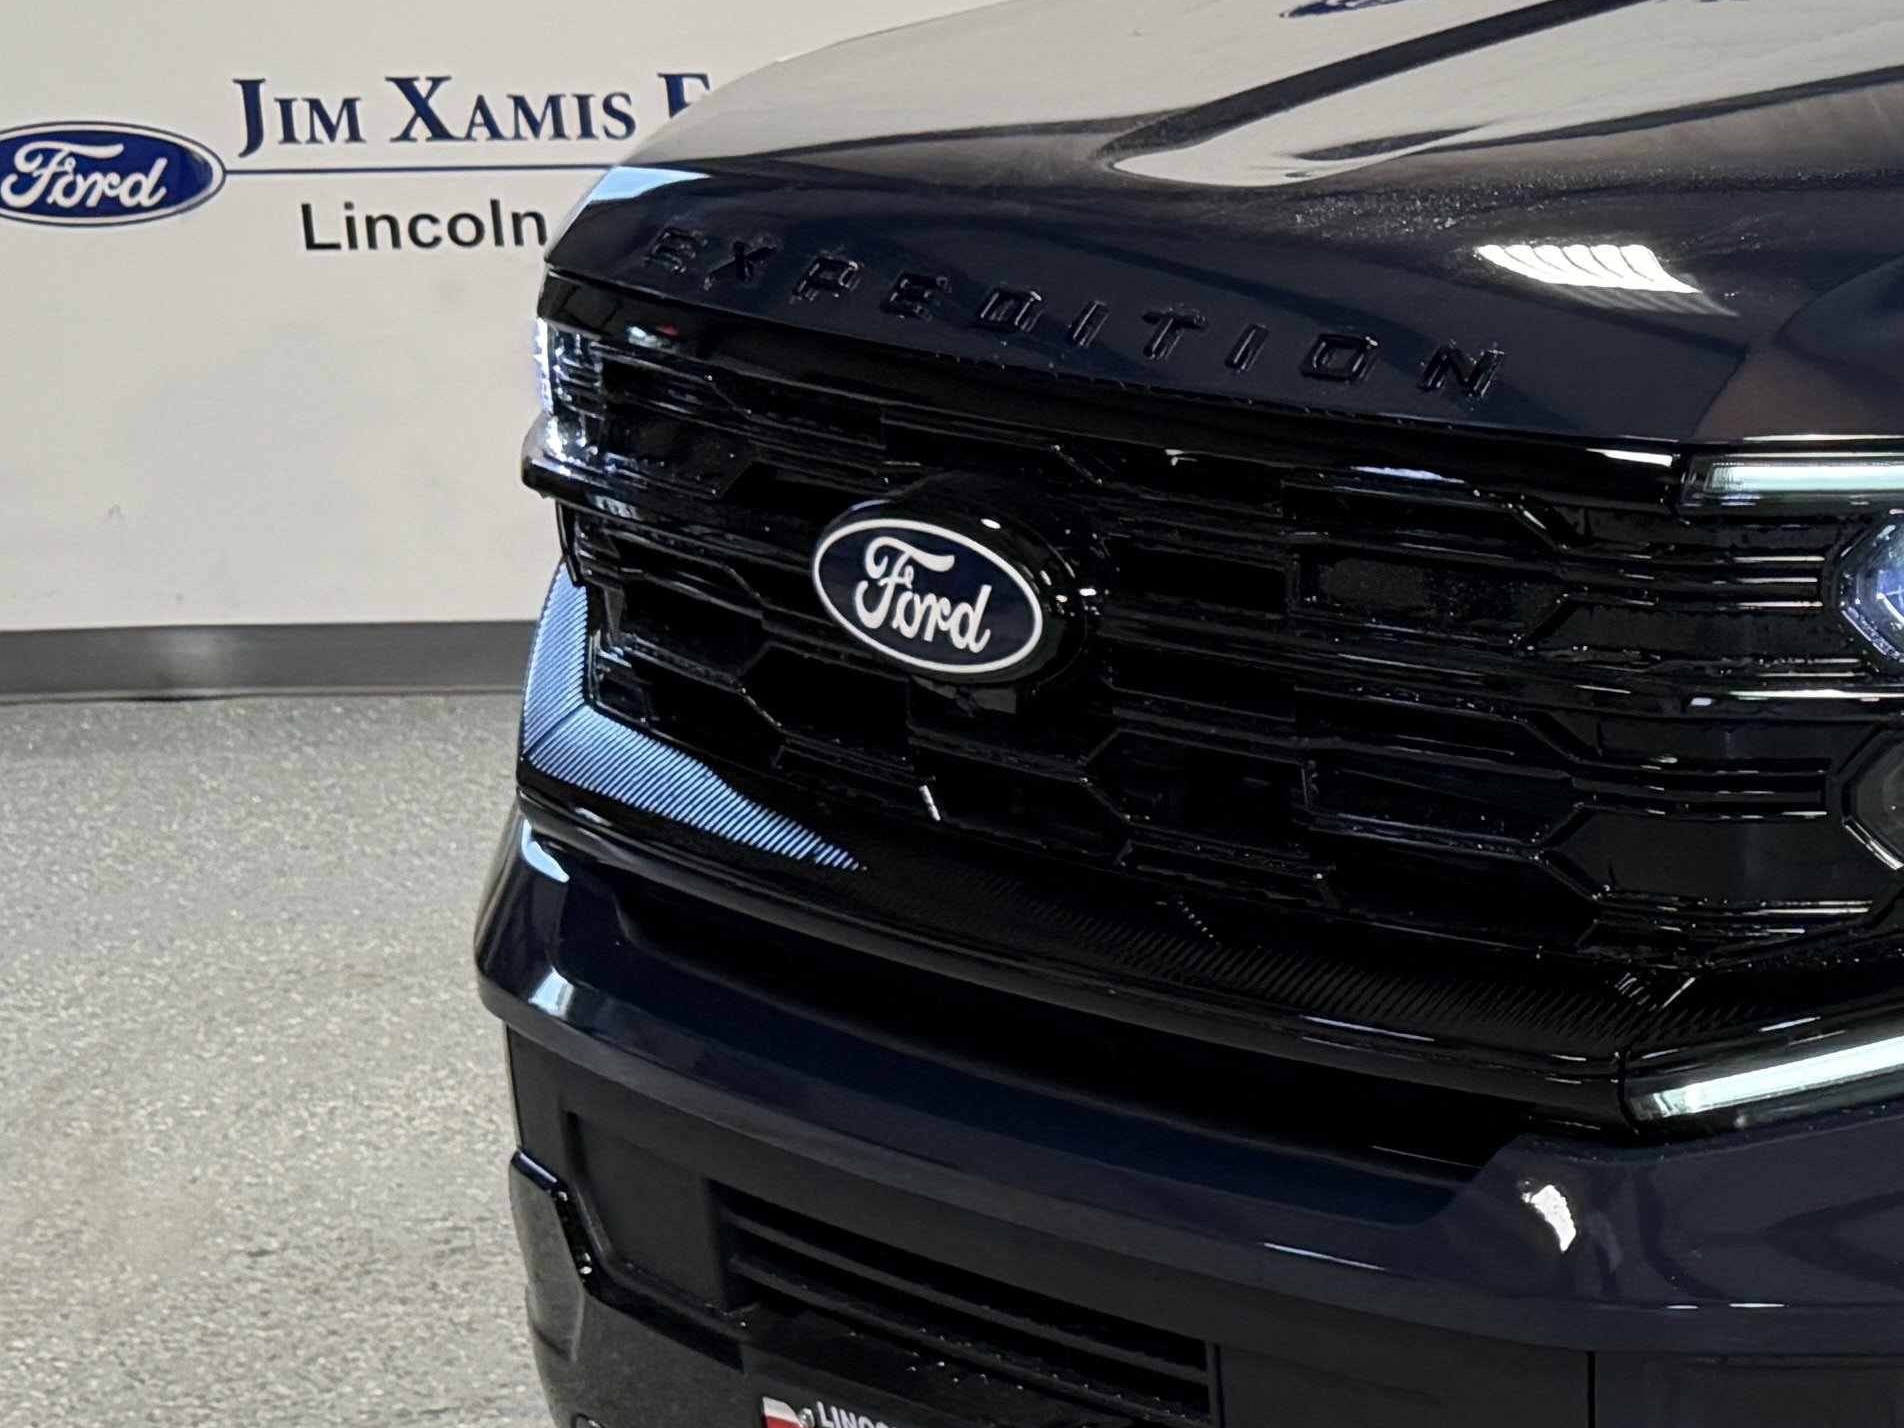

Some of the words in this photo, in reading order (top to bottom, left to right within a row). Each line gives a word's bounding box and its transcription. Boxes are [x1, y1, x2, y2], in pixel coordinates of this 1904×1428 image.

[231, 76, 367, 158] JIM
[383, 74, 638, 144] XAMIS
[1, 140, 168, 209] Ford
[643, 224, 1506, 398] EXPEDITION
[854, 533, 992, 655] Ford
